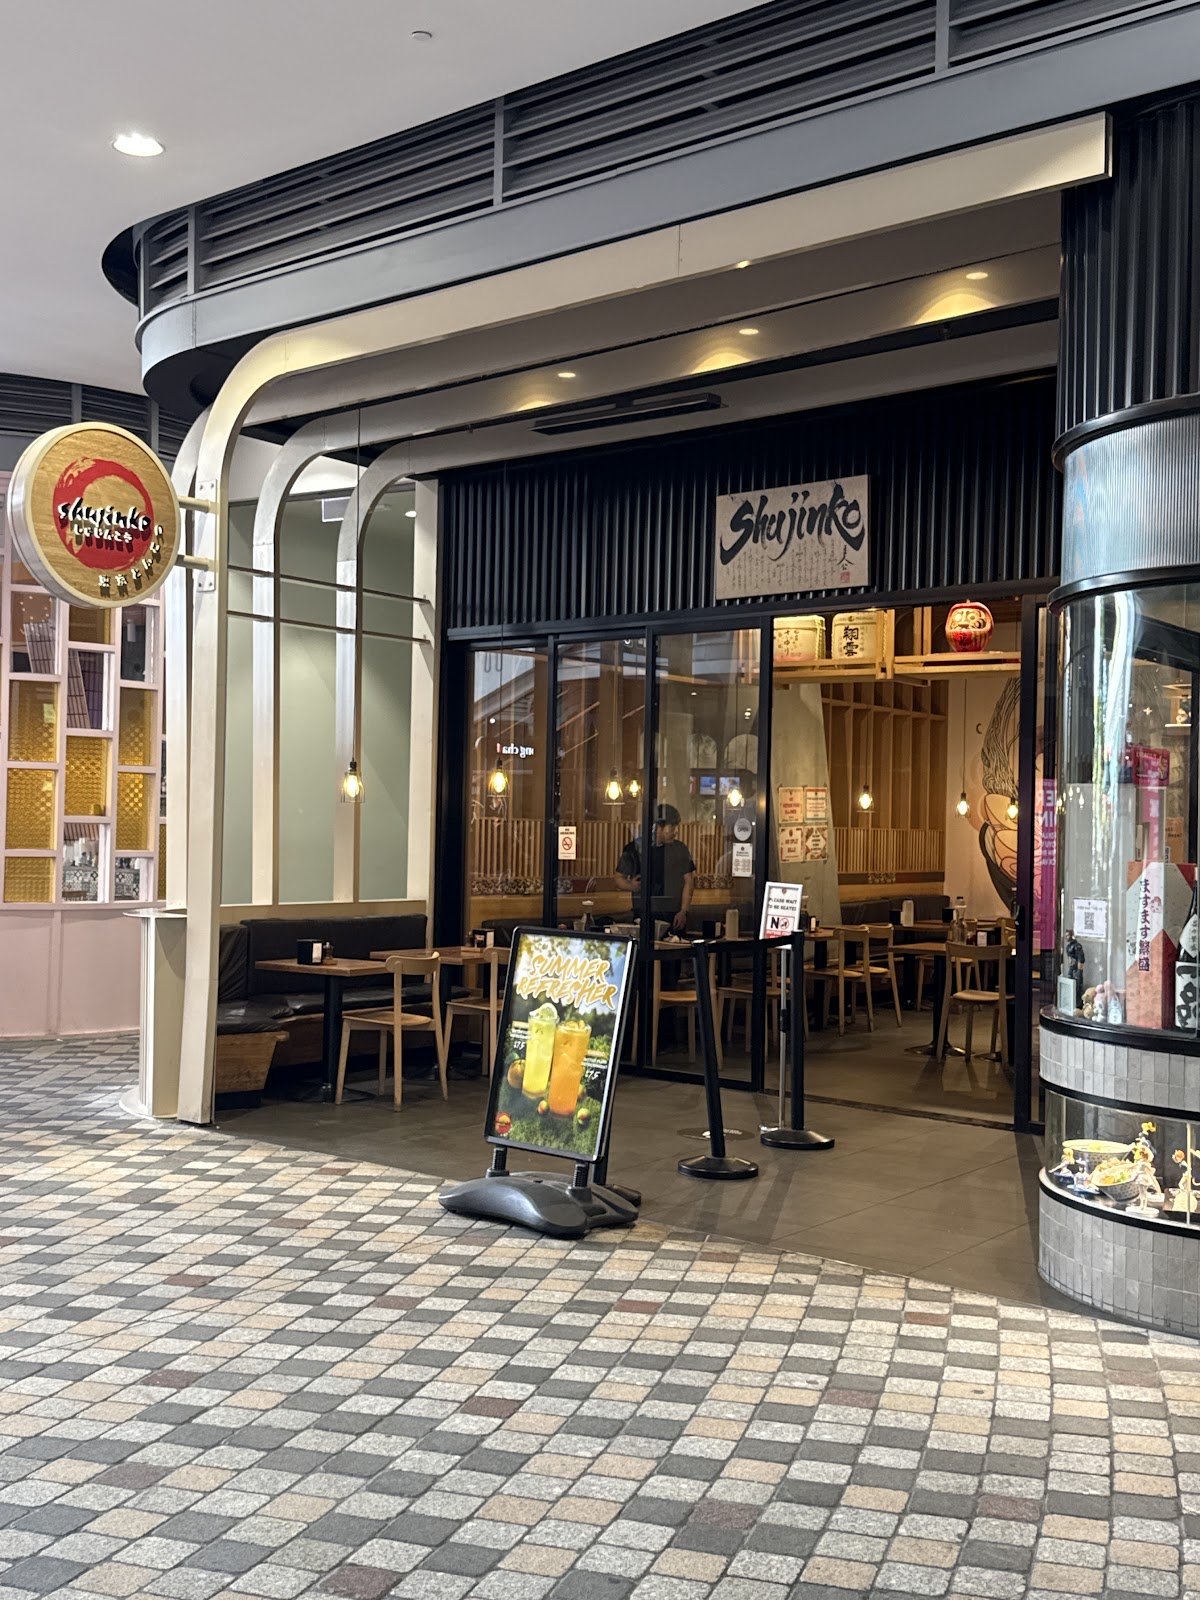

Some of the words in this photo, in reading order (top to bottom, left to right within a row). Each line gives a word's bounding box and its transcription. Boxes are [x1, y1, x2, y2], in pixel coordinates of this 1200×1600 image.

[720, 480, 865, 565] Shujinko
[529, 954, 610, 983] SUMMER
[516, 976, 618, 1010] REFRESHER
